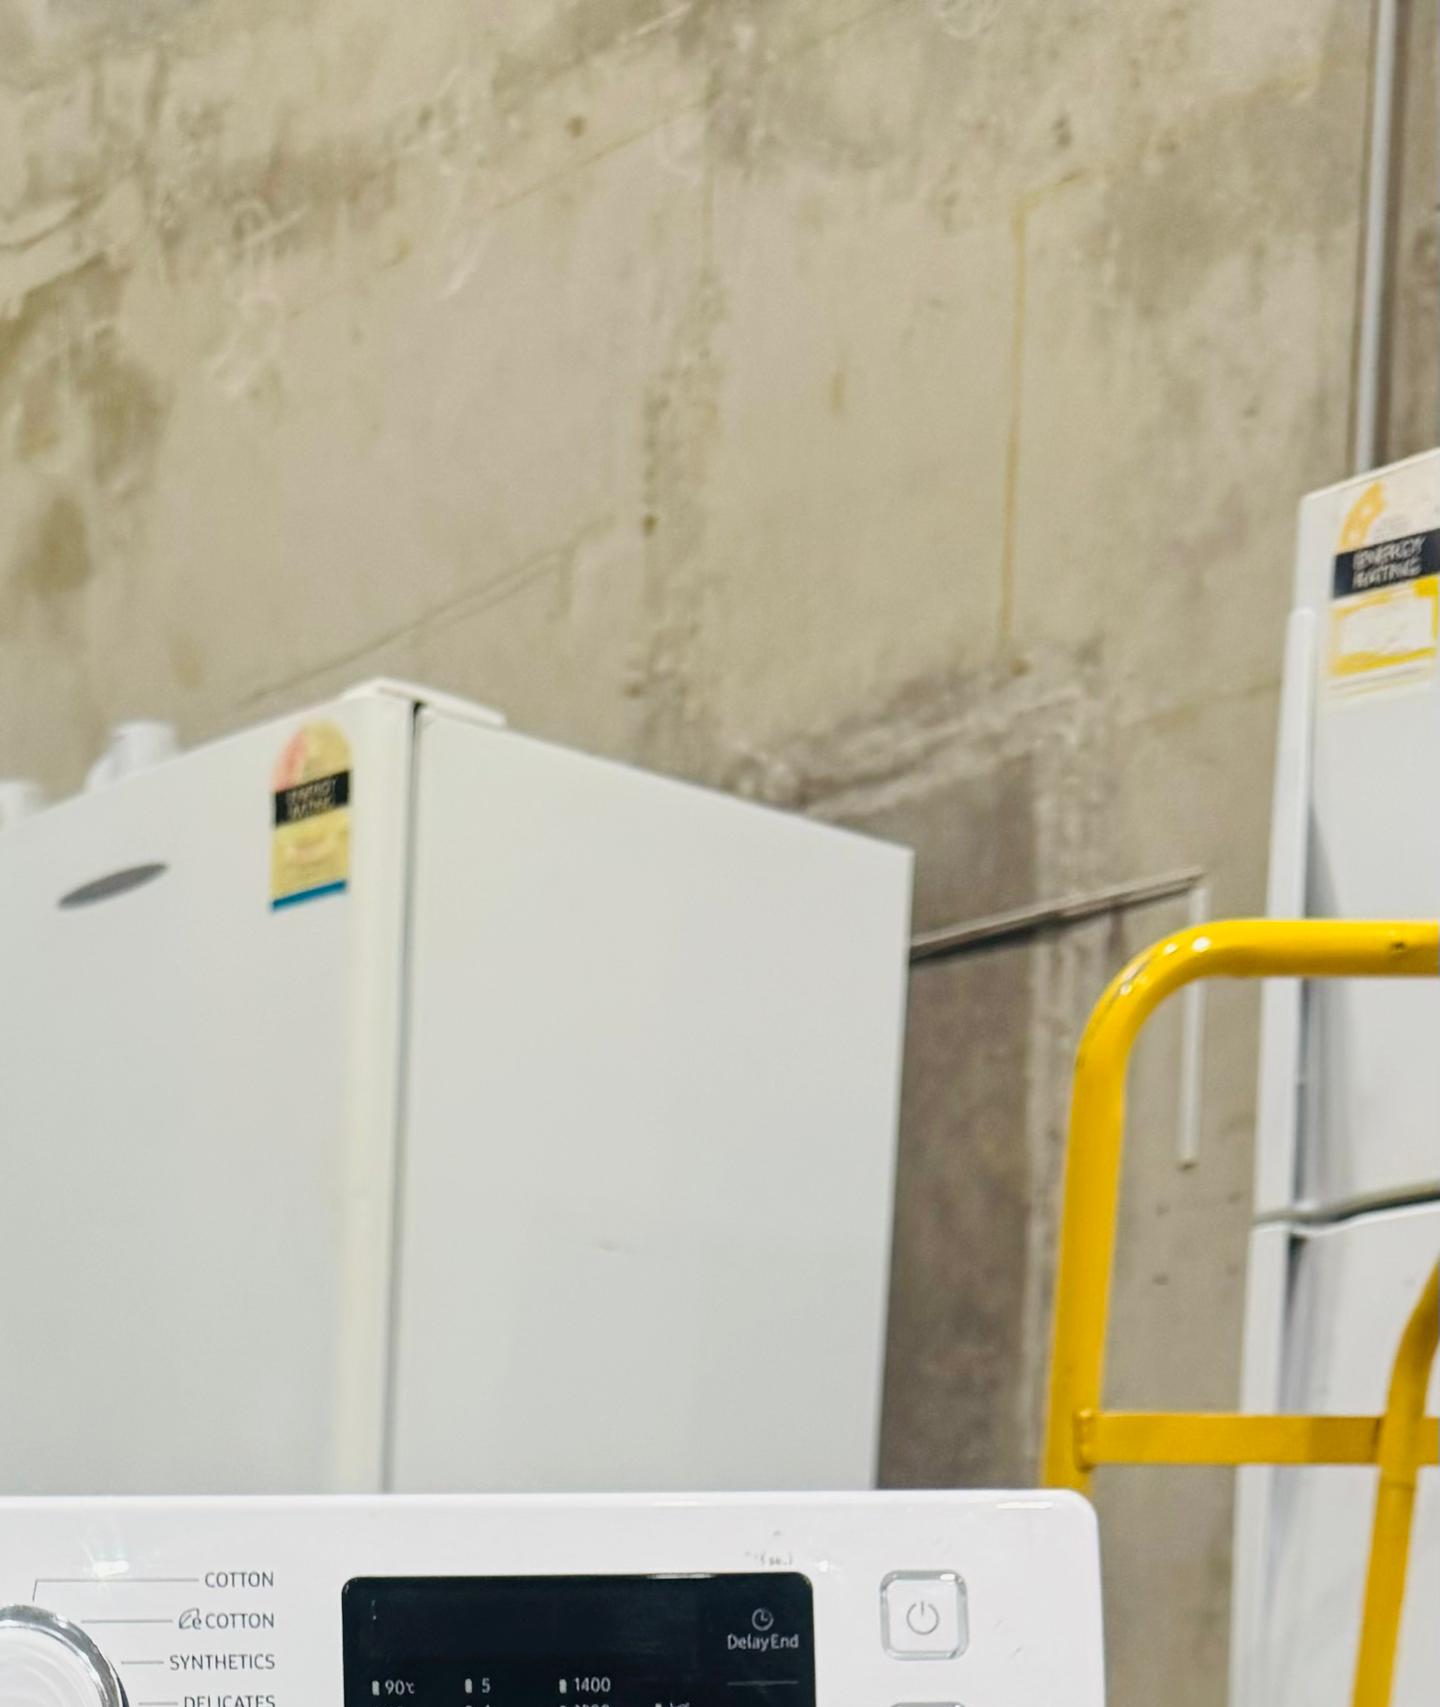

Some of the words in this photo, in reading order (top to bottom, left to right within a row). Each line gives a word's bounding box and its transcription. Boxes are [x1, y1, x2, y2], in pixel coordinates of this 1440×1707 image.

[204, 1571, 274, 1588] COTTON
[205, 1613, 275, 1629] COTTON
[727, 1634, 769, 1652] Delay
[770, 1634, 799, 1649] End
[169, 1653, 276, 1671] SYNTHETICS
[481, 1678, 491, 1694] 5
[574, 1677, 611, 1693] 1400
